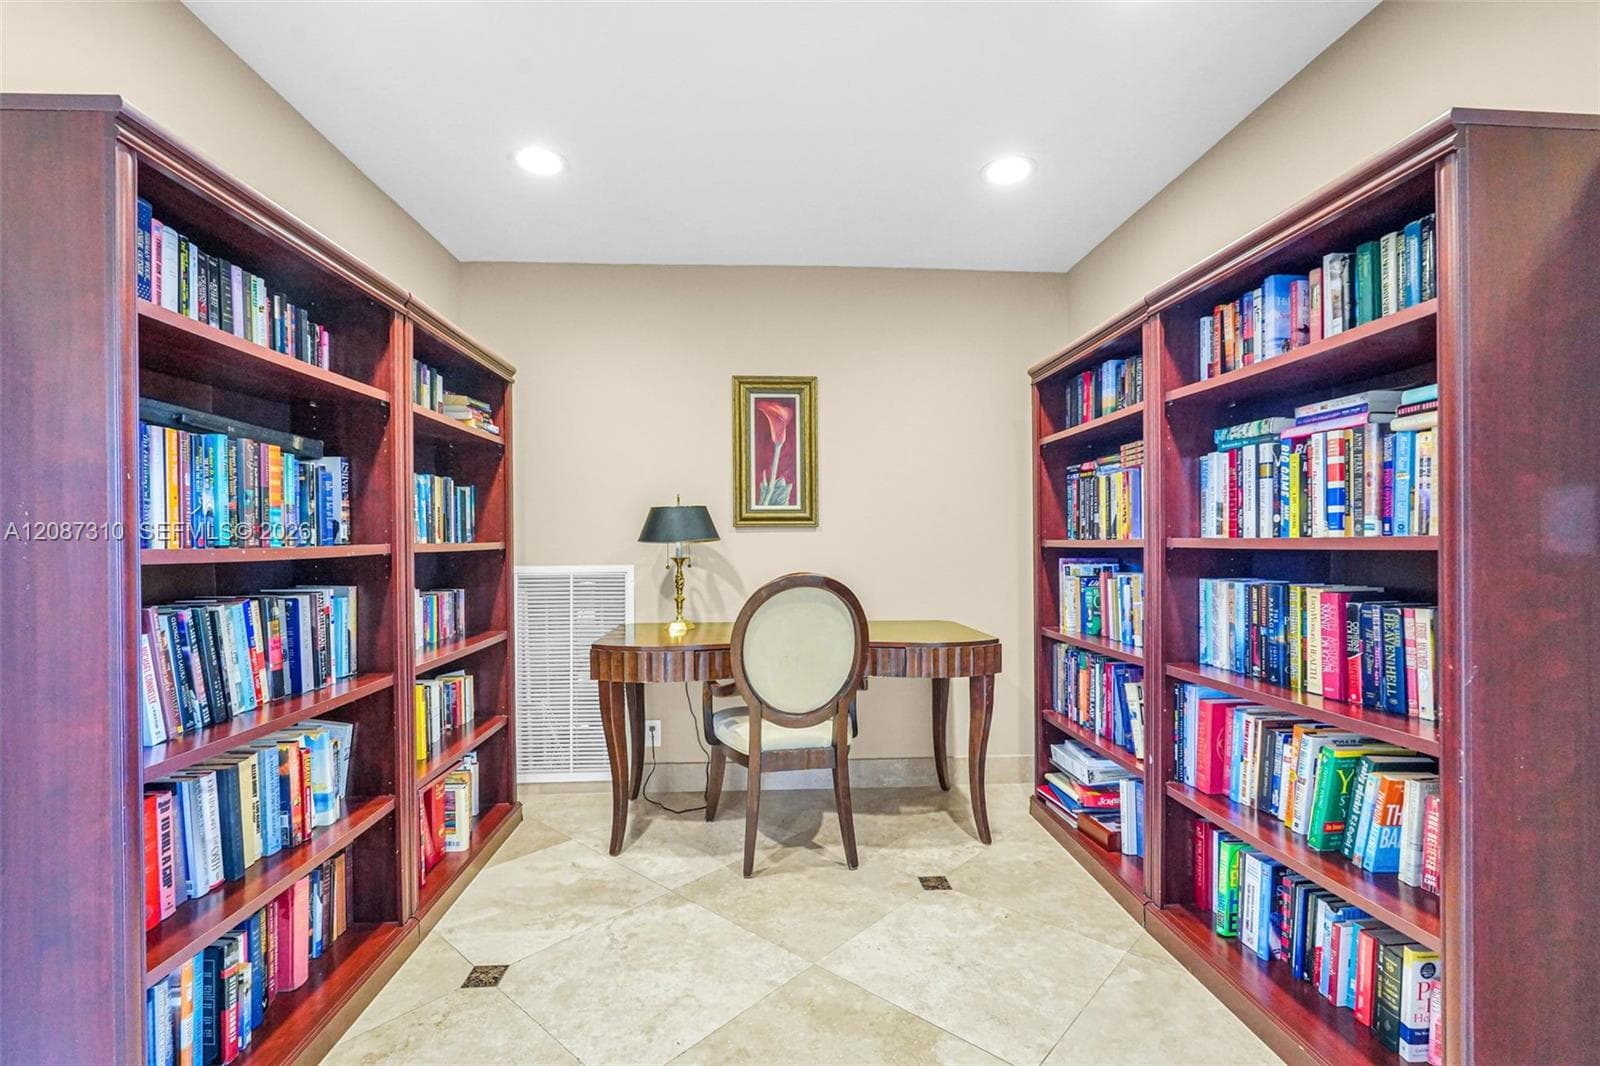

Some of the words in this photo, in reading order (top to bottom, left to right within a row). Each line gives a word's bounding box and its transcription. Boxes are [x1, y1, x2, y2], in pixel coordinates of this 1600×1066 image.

[1281, 444, 1290, 463] BIG
[1355, 433, 1363, 451] ANNE
[1355, 454, 1363, 474] PERRY
[1281, 466, 1290, 498] GAME
[171, 616, 180, 644] GEORGE
[178, 659, 186, 680] LAURA
[1384, 613, 1396, 661] HEAVEN
[1387, 666, 1399, 697] HELL
[1428, 811, 1439, 832] TRUE
[161, 831, 171, 856] KILL
[1426, 832, 1438, 871] BELIEVER
[162, 855, 171, 866] A
